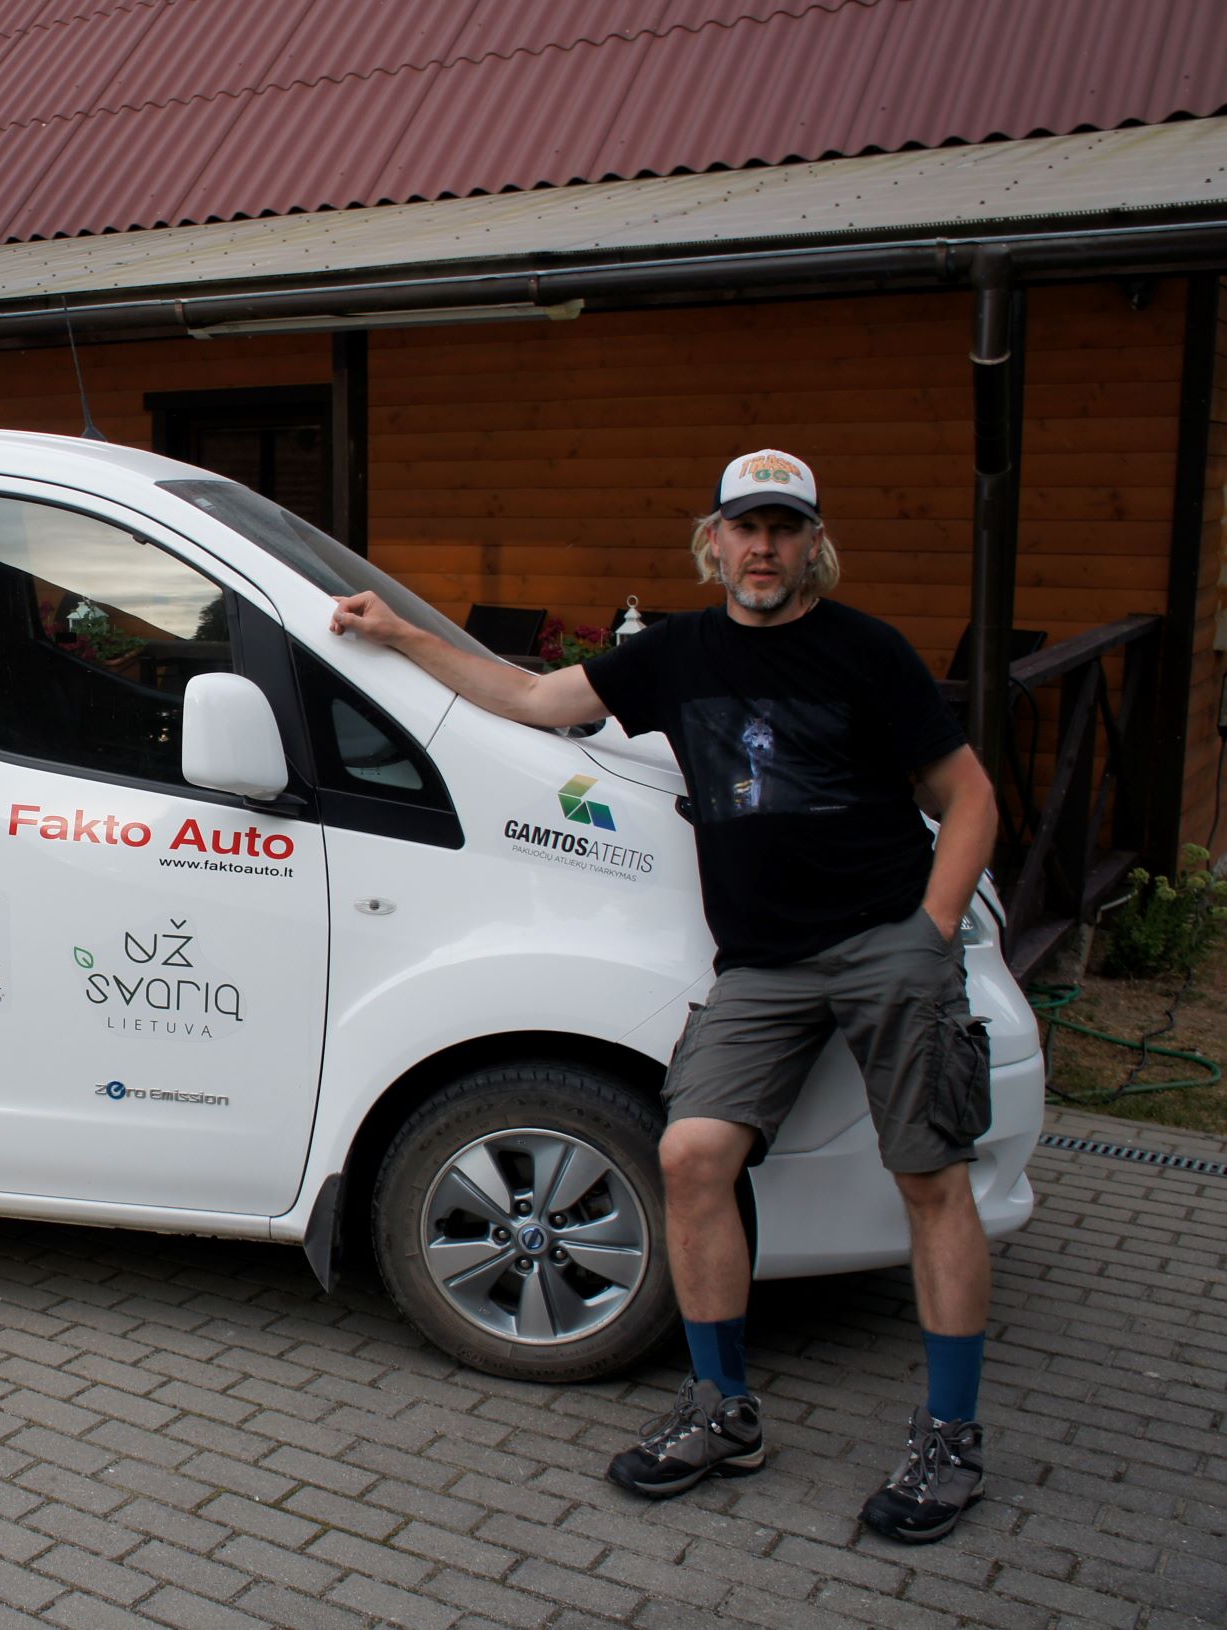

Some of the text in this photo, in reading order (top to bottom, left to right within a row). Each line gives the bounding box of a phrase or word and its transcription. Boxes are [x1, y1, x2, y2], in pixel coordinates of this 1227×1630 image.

[8, 804, 294, 860] Fakto Auto
[504, 819, 654, 873] GAMTOSATEITIS
[159, 858, 294, 878] www.faktoauto.lt
[589, 864, 637, 881] TVARKYMAS
[149, 1089, 230, 1106] Emission
